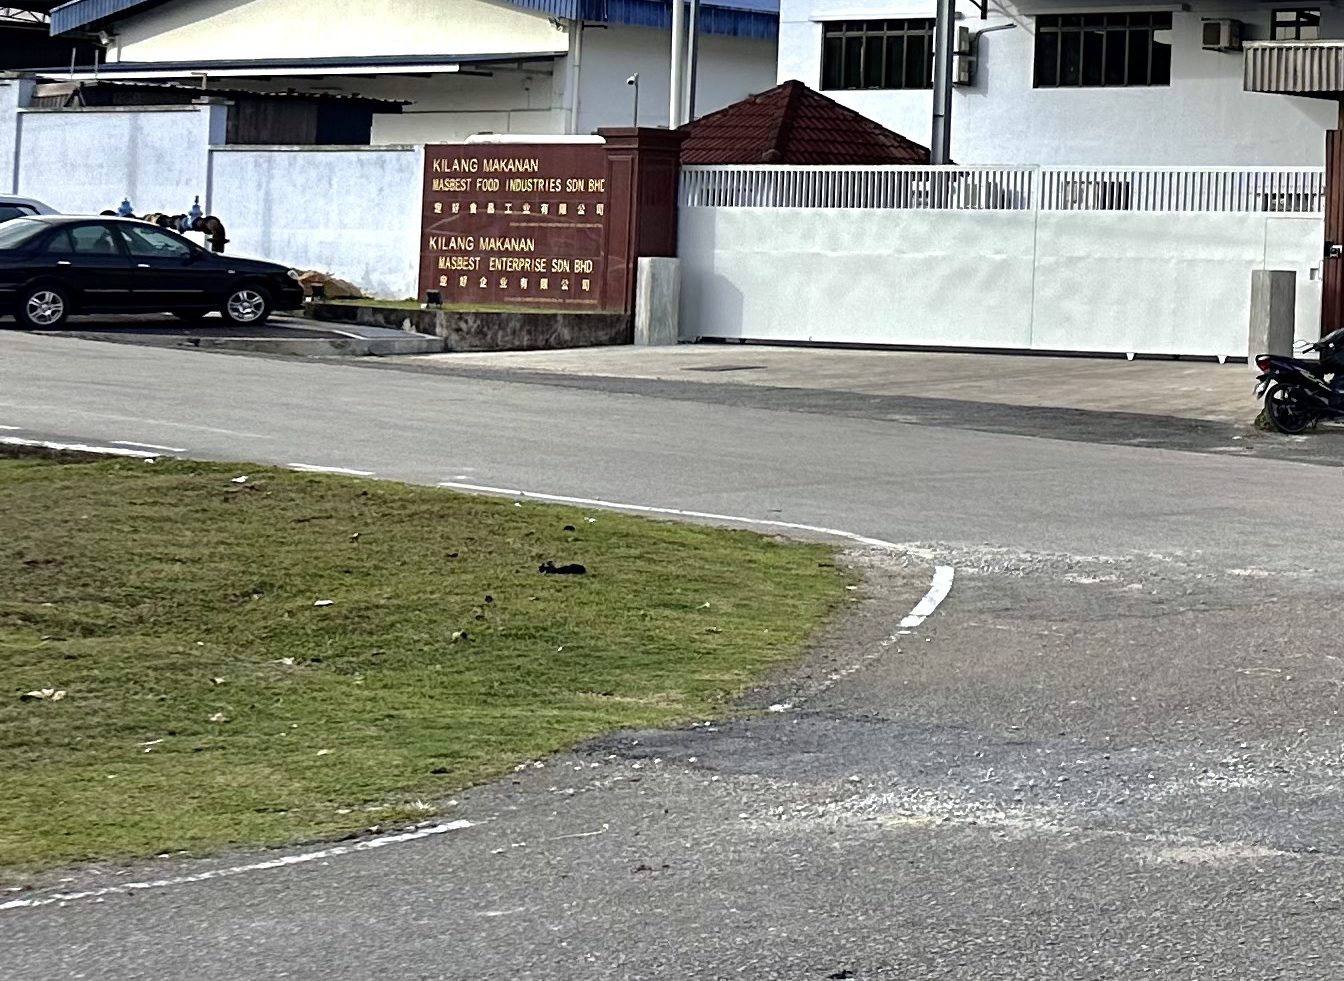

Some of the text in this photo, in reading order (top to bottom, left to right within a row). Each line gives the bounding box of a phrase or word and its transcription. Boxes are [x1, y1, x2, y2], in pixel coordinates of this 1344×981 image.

[432, 158, 539, 173] KILANG MAKANAN
[432, 178, 472, 192] MASBEST
[476, 178, 500, 192] FOOD
[505, 178, 562, 193] INDUSTRIES
[429, 236, 535, 252] KILANG MAKANAN
[438, 256, 480, 270] MASBEST
[489, 257, 547, 272] ENTERPRISE
